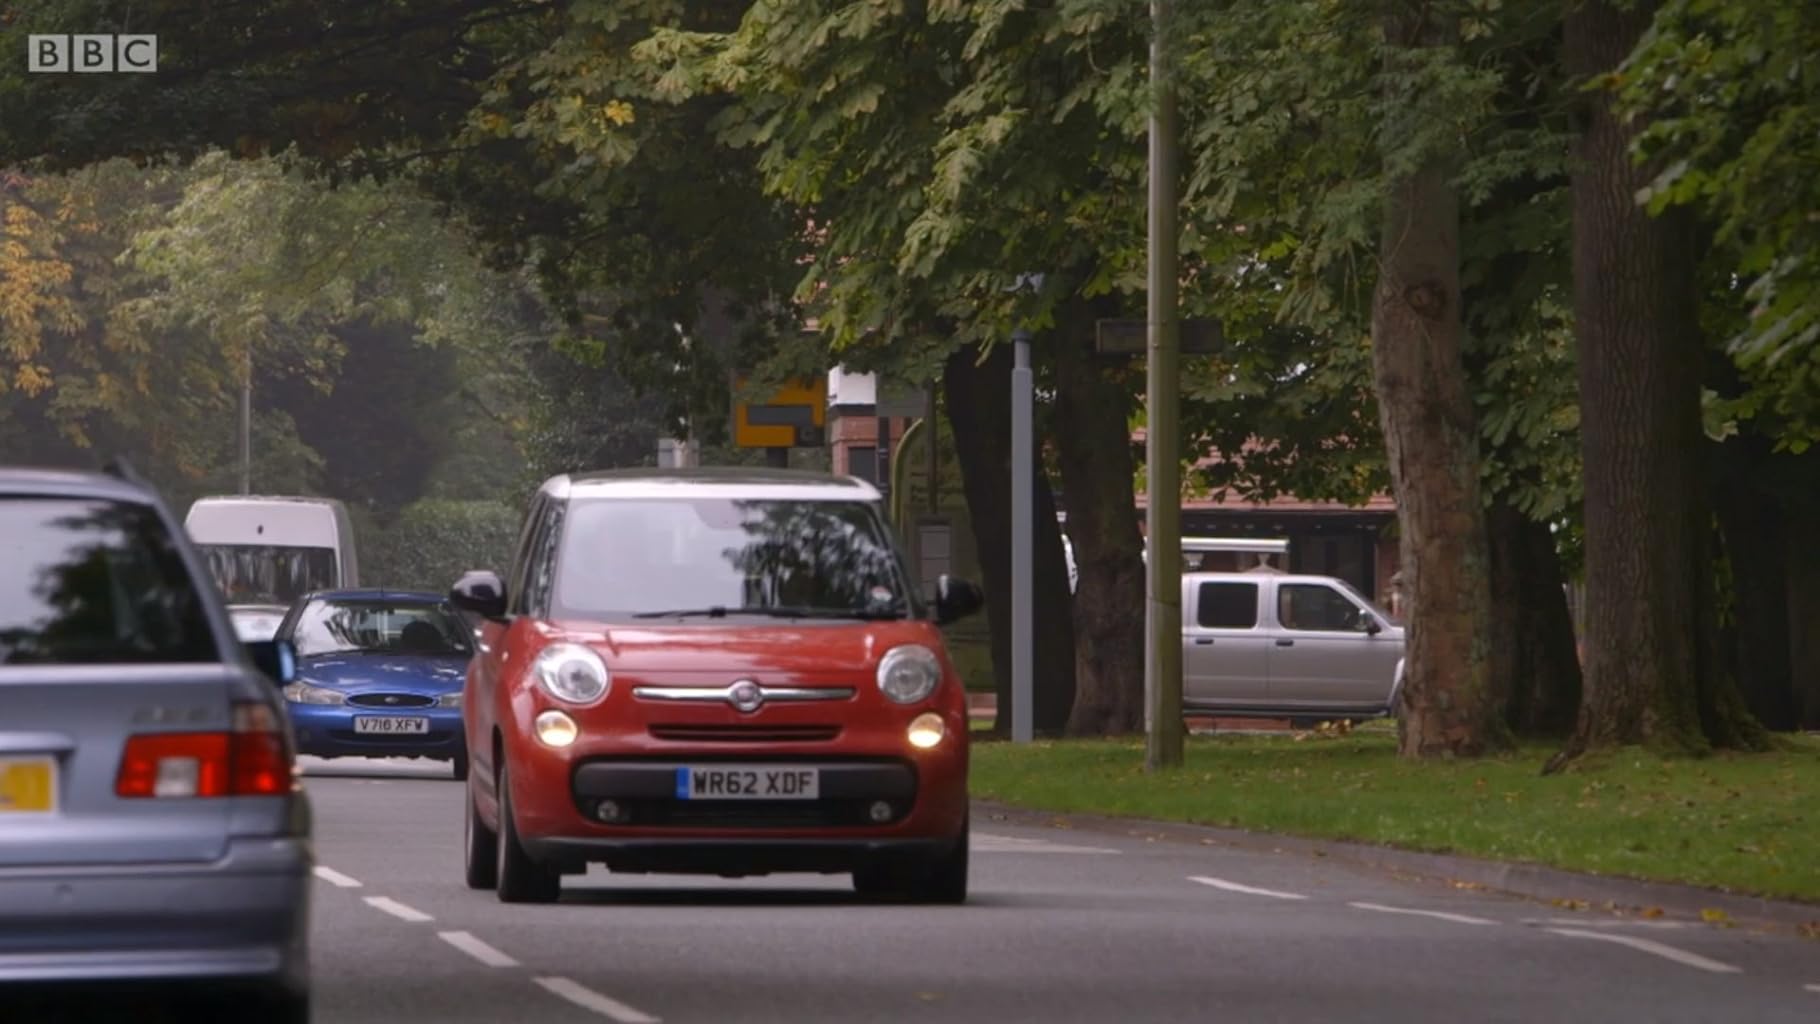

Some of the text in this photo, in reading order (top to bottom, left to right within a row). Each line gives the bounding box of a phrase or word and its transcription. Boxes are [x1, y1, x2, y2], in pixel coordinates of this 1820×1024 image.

[360, 718, 423, 731] V716 XFW
[693, 771, 813, 795] WR62 XDF
